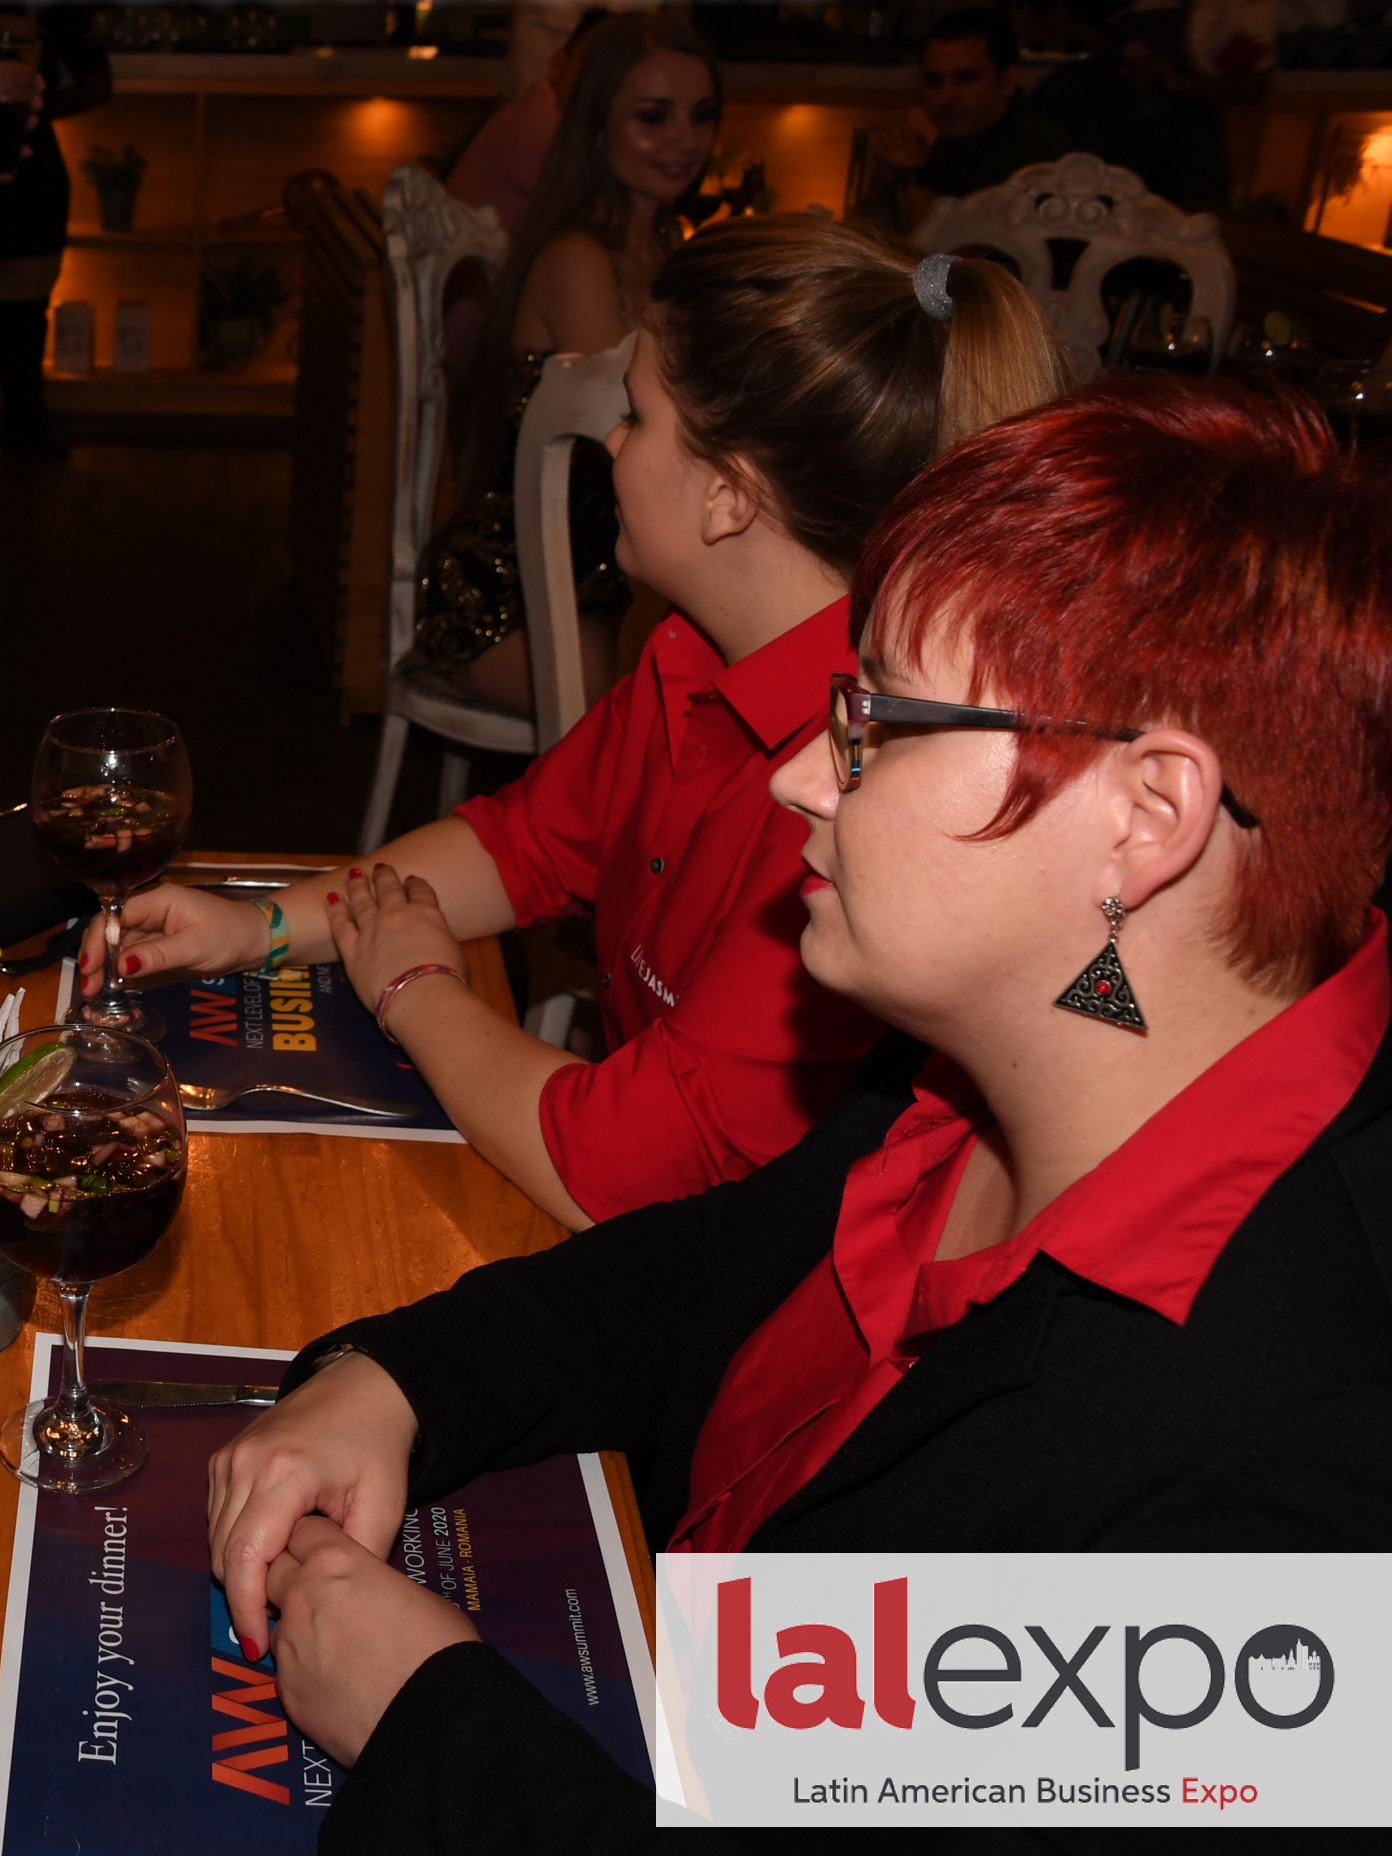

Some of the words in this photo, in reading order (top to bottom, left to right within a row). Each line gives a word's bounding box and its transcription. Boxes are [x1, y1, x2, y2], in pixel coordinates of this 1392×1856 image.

[244, 993, 263, 1021] LEVEL
[245, 1020, 264, 1049] NEXT
[430, 1507, 449, 1536] 2020
[453, 1508, 474, 1558] ROMANIA
[88, 1505, 128, 1595] dinner!
[435, 1539, 455, 1571] JUNE
[440, 1572, 458, 1590] OF
[461, 1565, 482, 1611] MAMAIA
[96, 1600, 135, 1666] your
[565, 1588, 599, 1706] www.awsummit.com
[78, 1670, 134, 1765] Enjoy
[302, 1740, 333, 1806] NEXT
